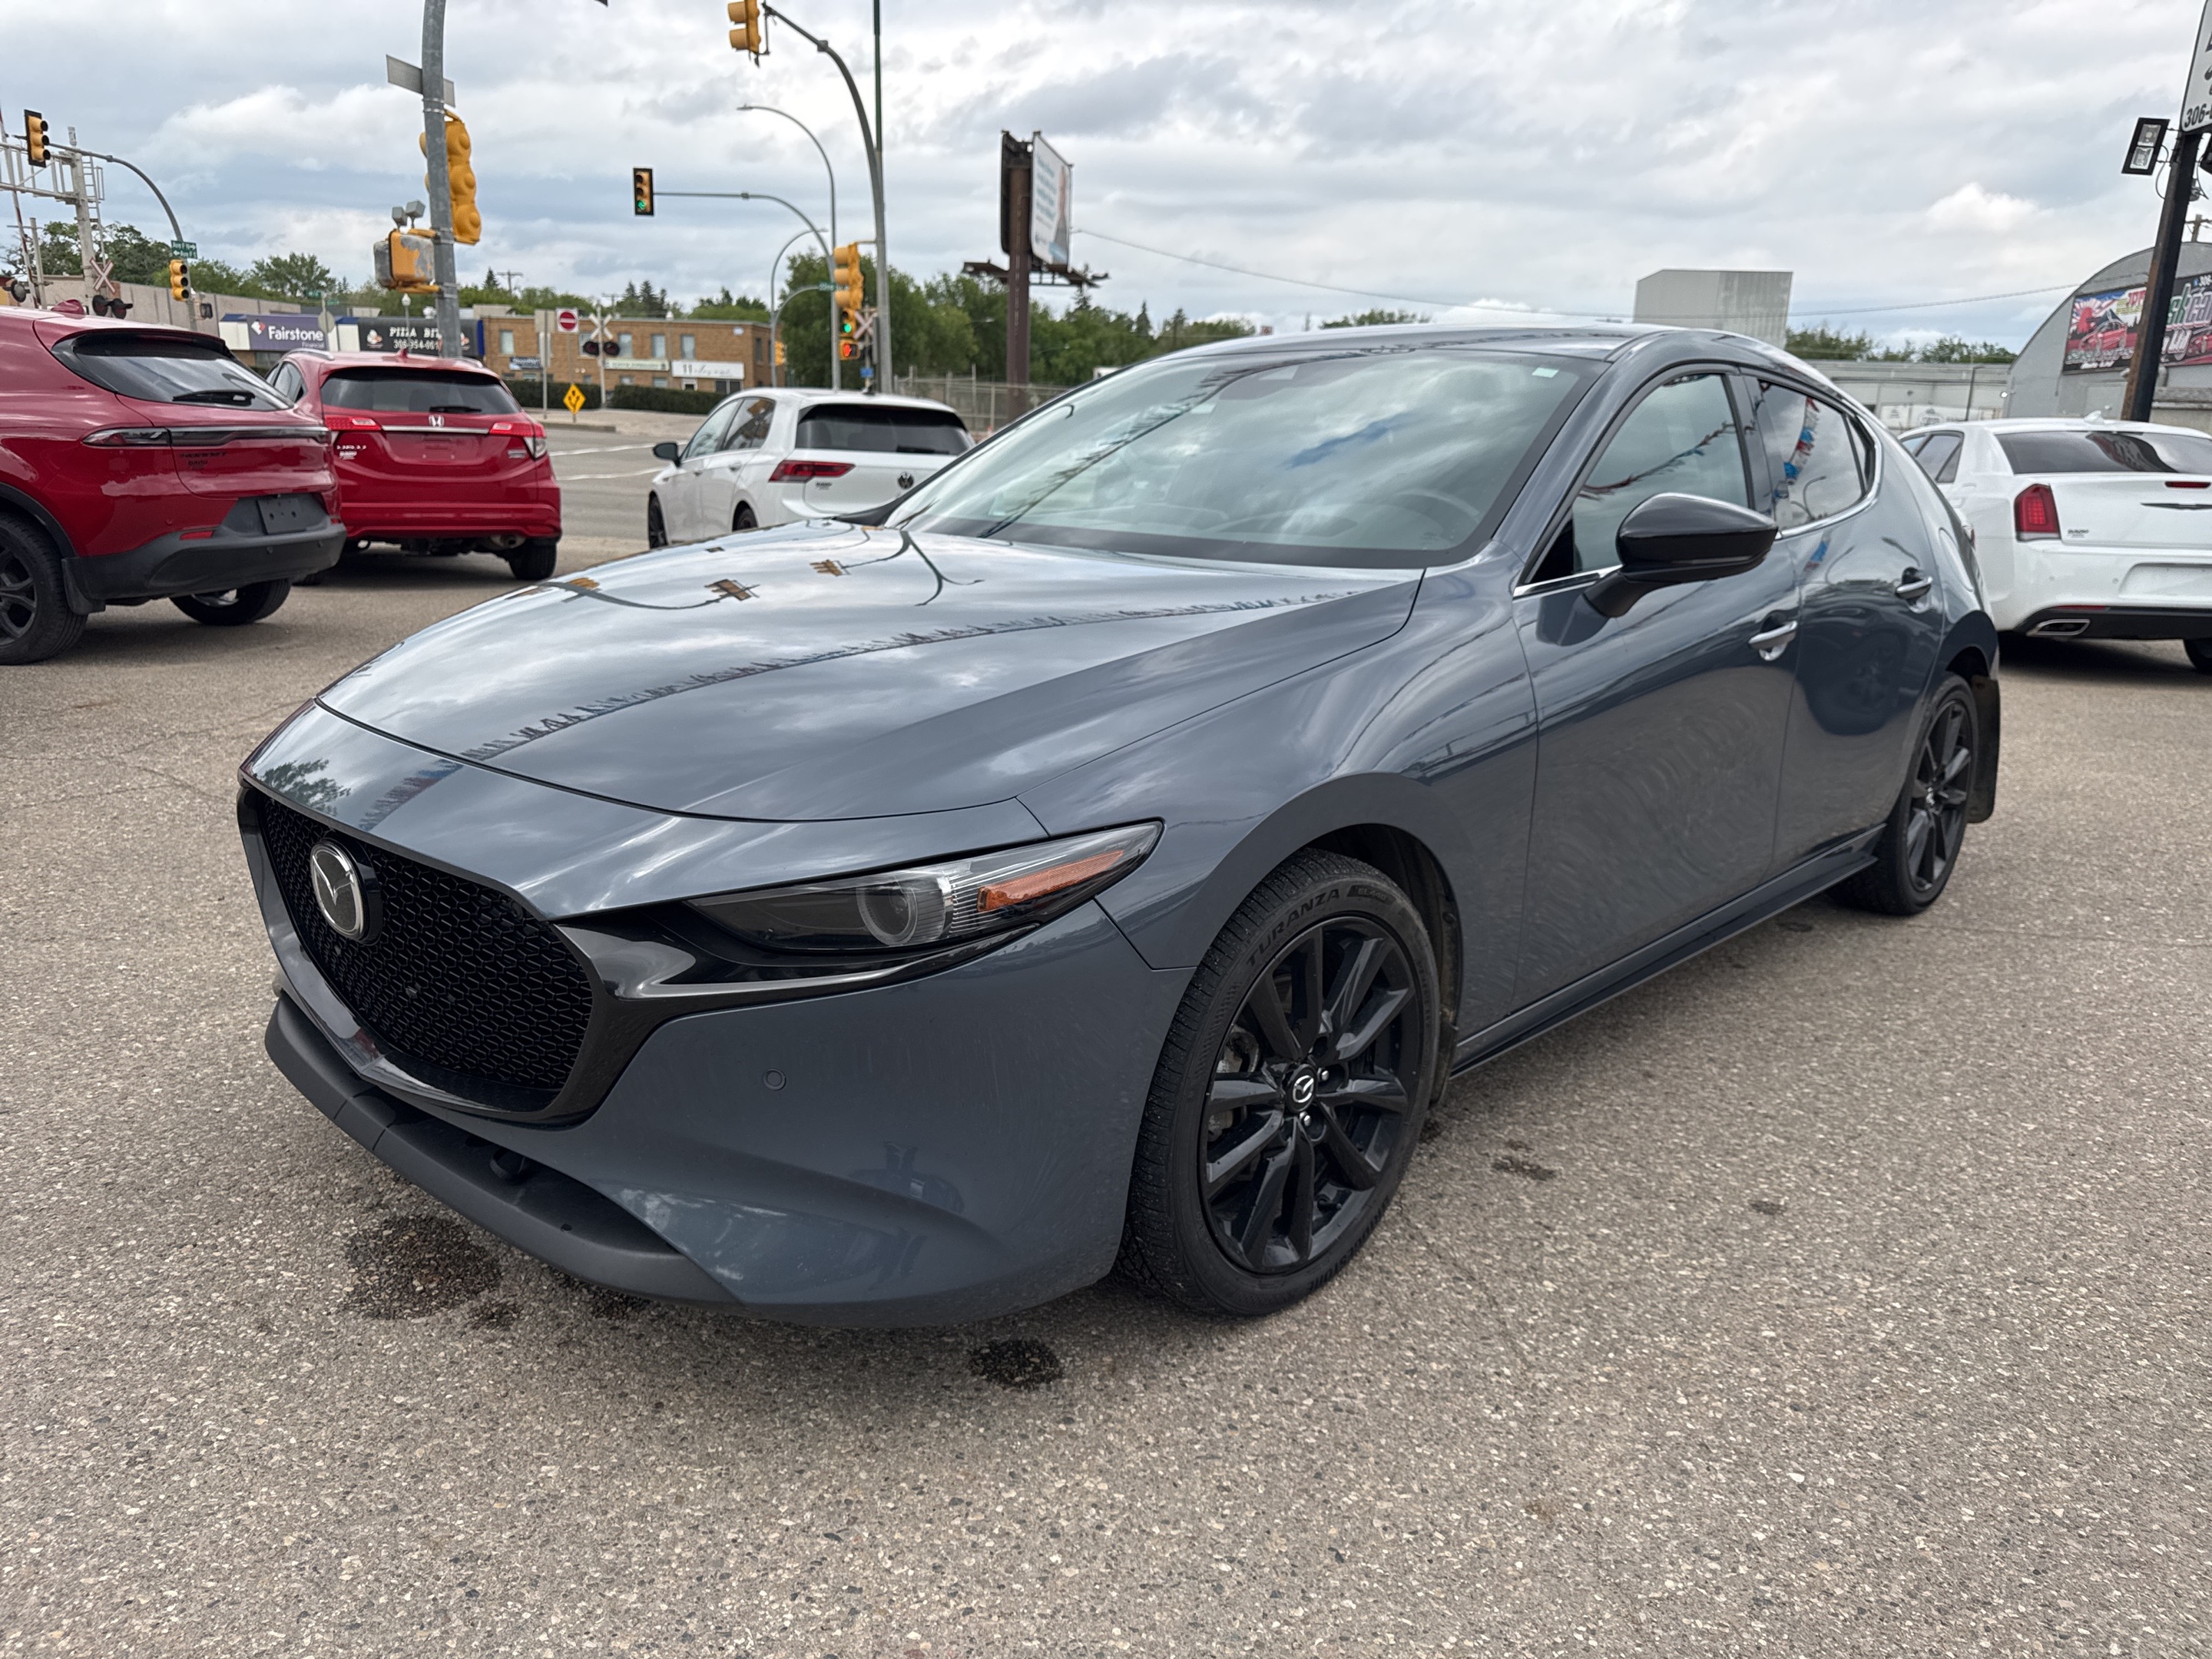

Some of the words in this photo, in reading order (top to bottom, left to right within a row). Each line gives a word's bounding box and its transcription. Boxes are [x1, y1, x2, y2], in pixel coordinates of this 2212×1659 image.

[268, 325, 323, 341] Fairstone
[1246, 889, 1340, 967] TURANZA
[1358, 887, 1388, 902] EL440
